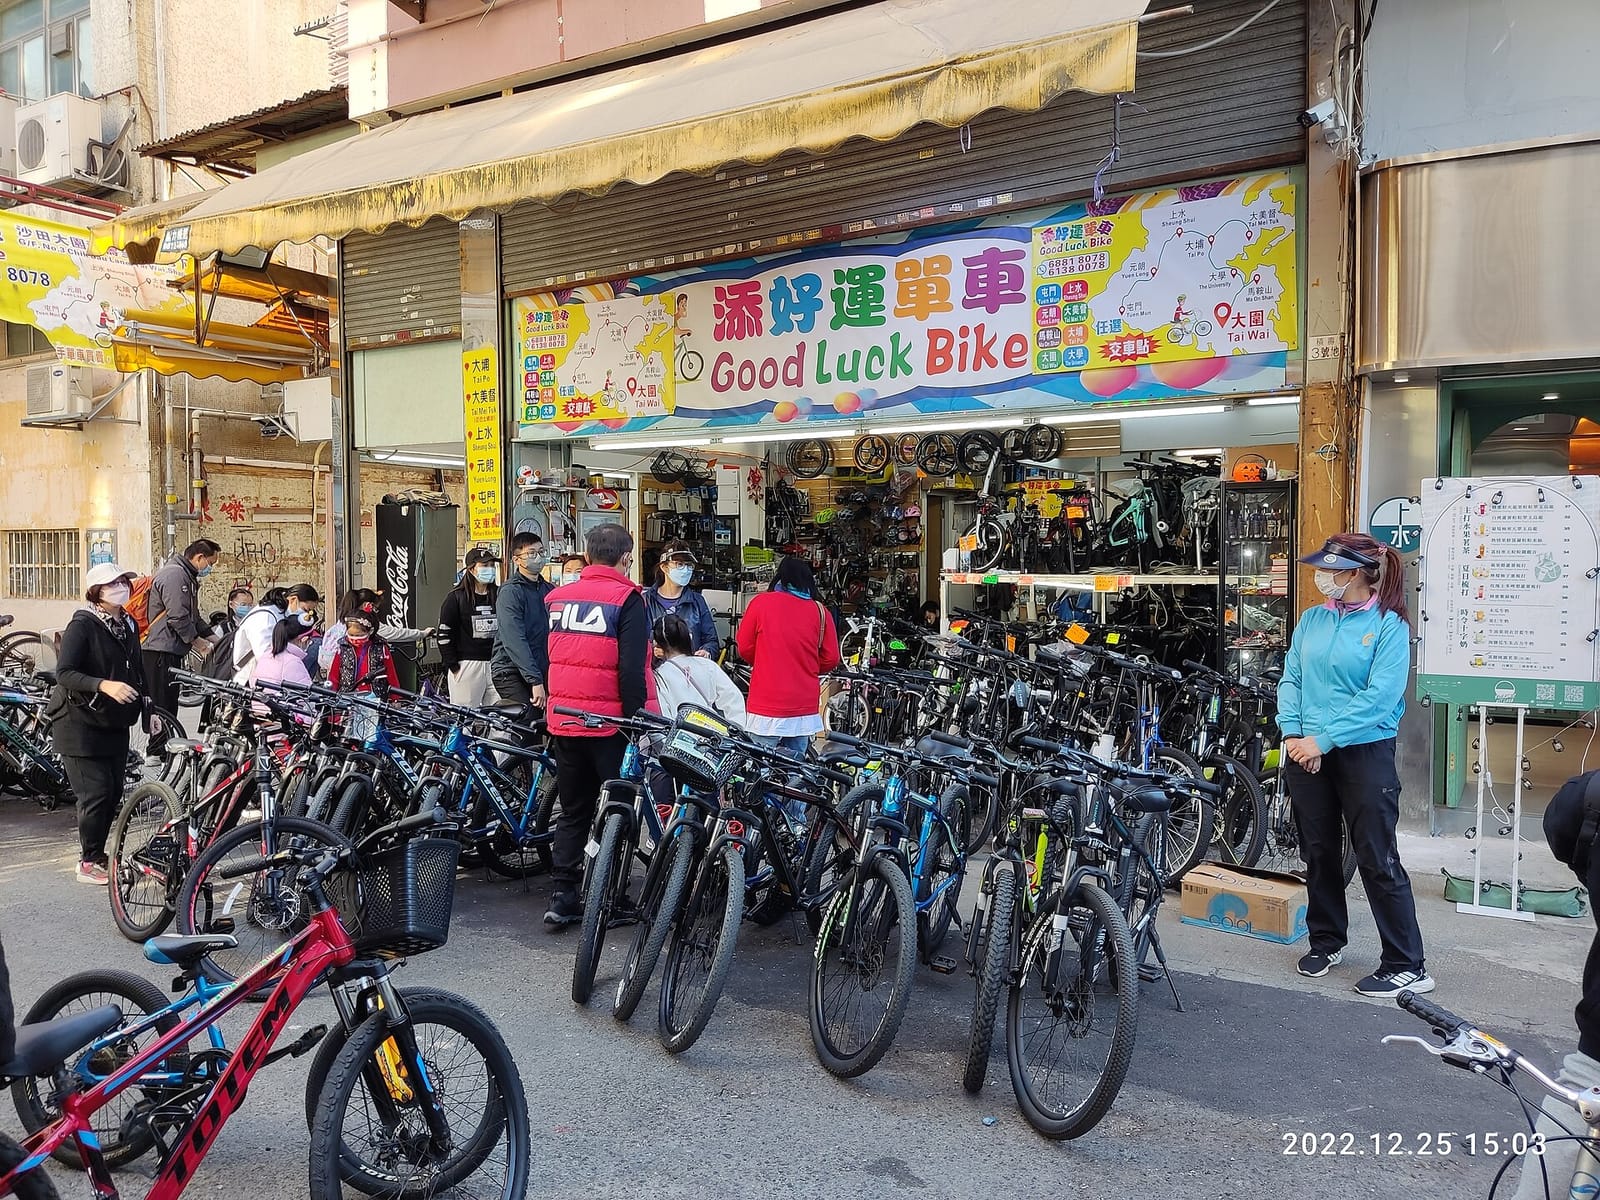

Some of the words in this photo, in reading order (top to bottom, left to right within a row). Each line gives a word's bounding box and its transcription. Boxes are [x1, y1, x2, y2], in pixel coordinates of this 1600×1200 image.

[1170, 208, 1186, 220] 上水
[1250, 208, 1276, 221] 大美督
[1040, 220, 1114, 245] 添好運單車
[1040, 244, 1063, 256] Good
[1065, 240, 1087, 251] Luck
[1090, 237, 1113, 248] Bike
[1048, 257, 1075, 268] 6881
[1078, 253, 1106, 264] 8078
[1048, 265, 1075, 276] 6138
[1078, 260, 1106, 272] 0078
[7, 266, 51, 287] 8078
[713, 247, 1027, 342] 添好運單車
[1231, 310, 1264, 328] 大圍
[1227, 332, 1244, 342] Tai
[1248, 329, 1270, 340] Wai
[1108, 339, 1150, 358] 交車點
[472, 358, 490, 373] 大埔
[711, 341, 806, 393] Good
[815, 331, 914, 385] Luck
[925, 322, 1029, 376] Bike
[472, 388, 496, 404] 大美督
[637, 384, 657, 398] 大圍
[635, 399, 646, 408] Tai
[647, 399, 660, 408] Wai
[475, 426, 492, 441] 上水
[477, 458, 494, 473] 元朗
[478, 490, 496, 504] 屯門
[550, 602, 608, 633] FILA
[163, 987, 293, 1185] TOTEM
